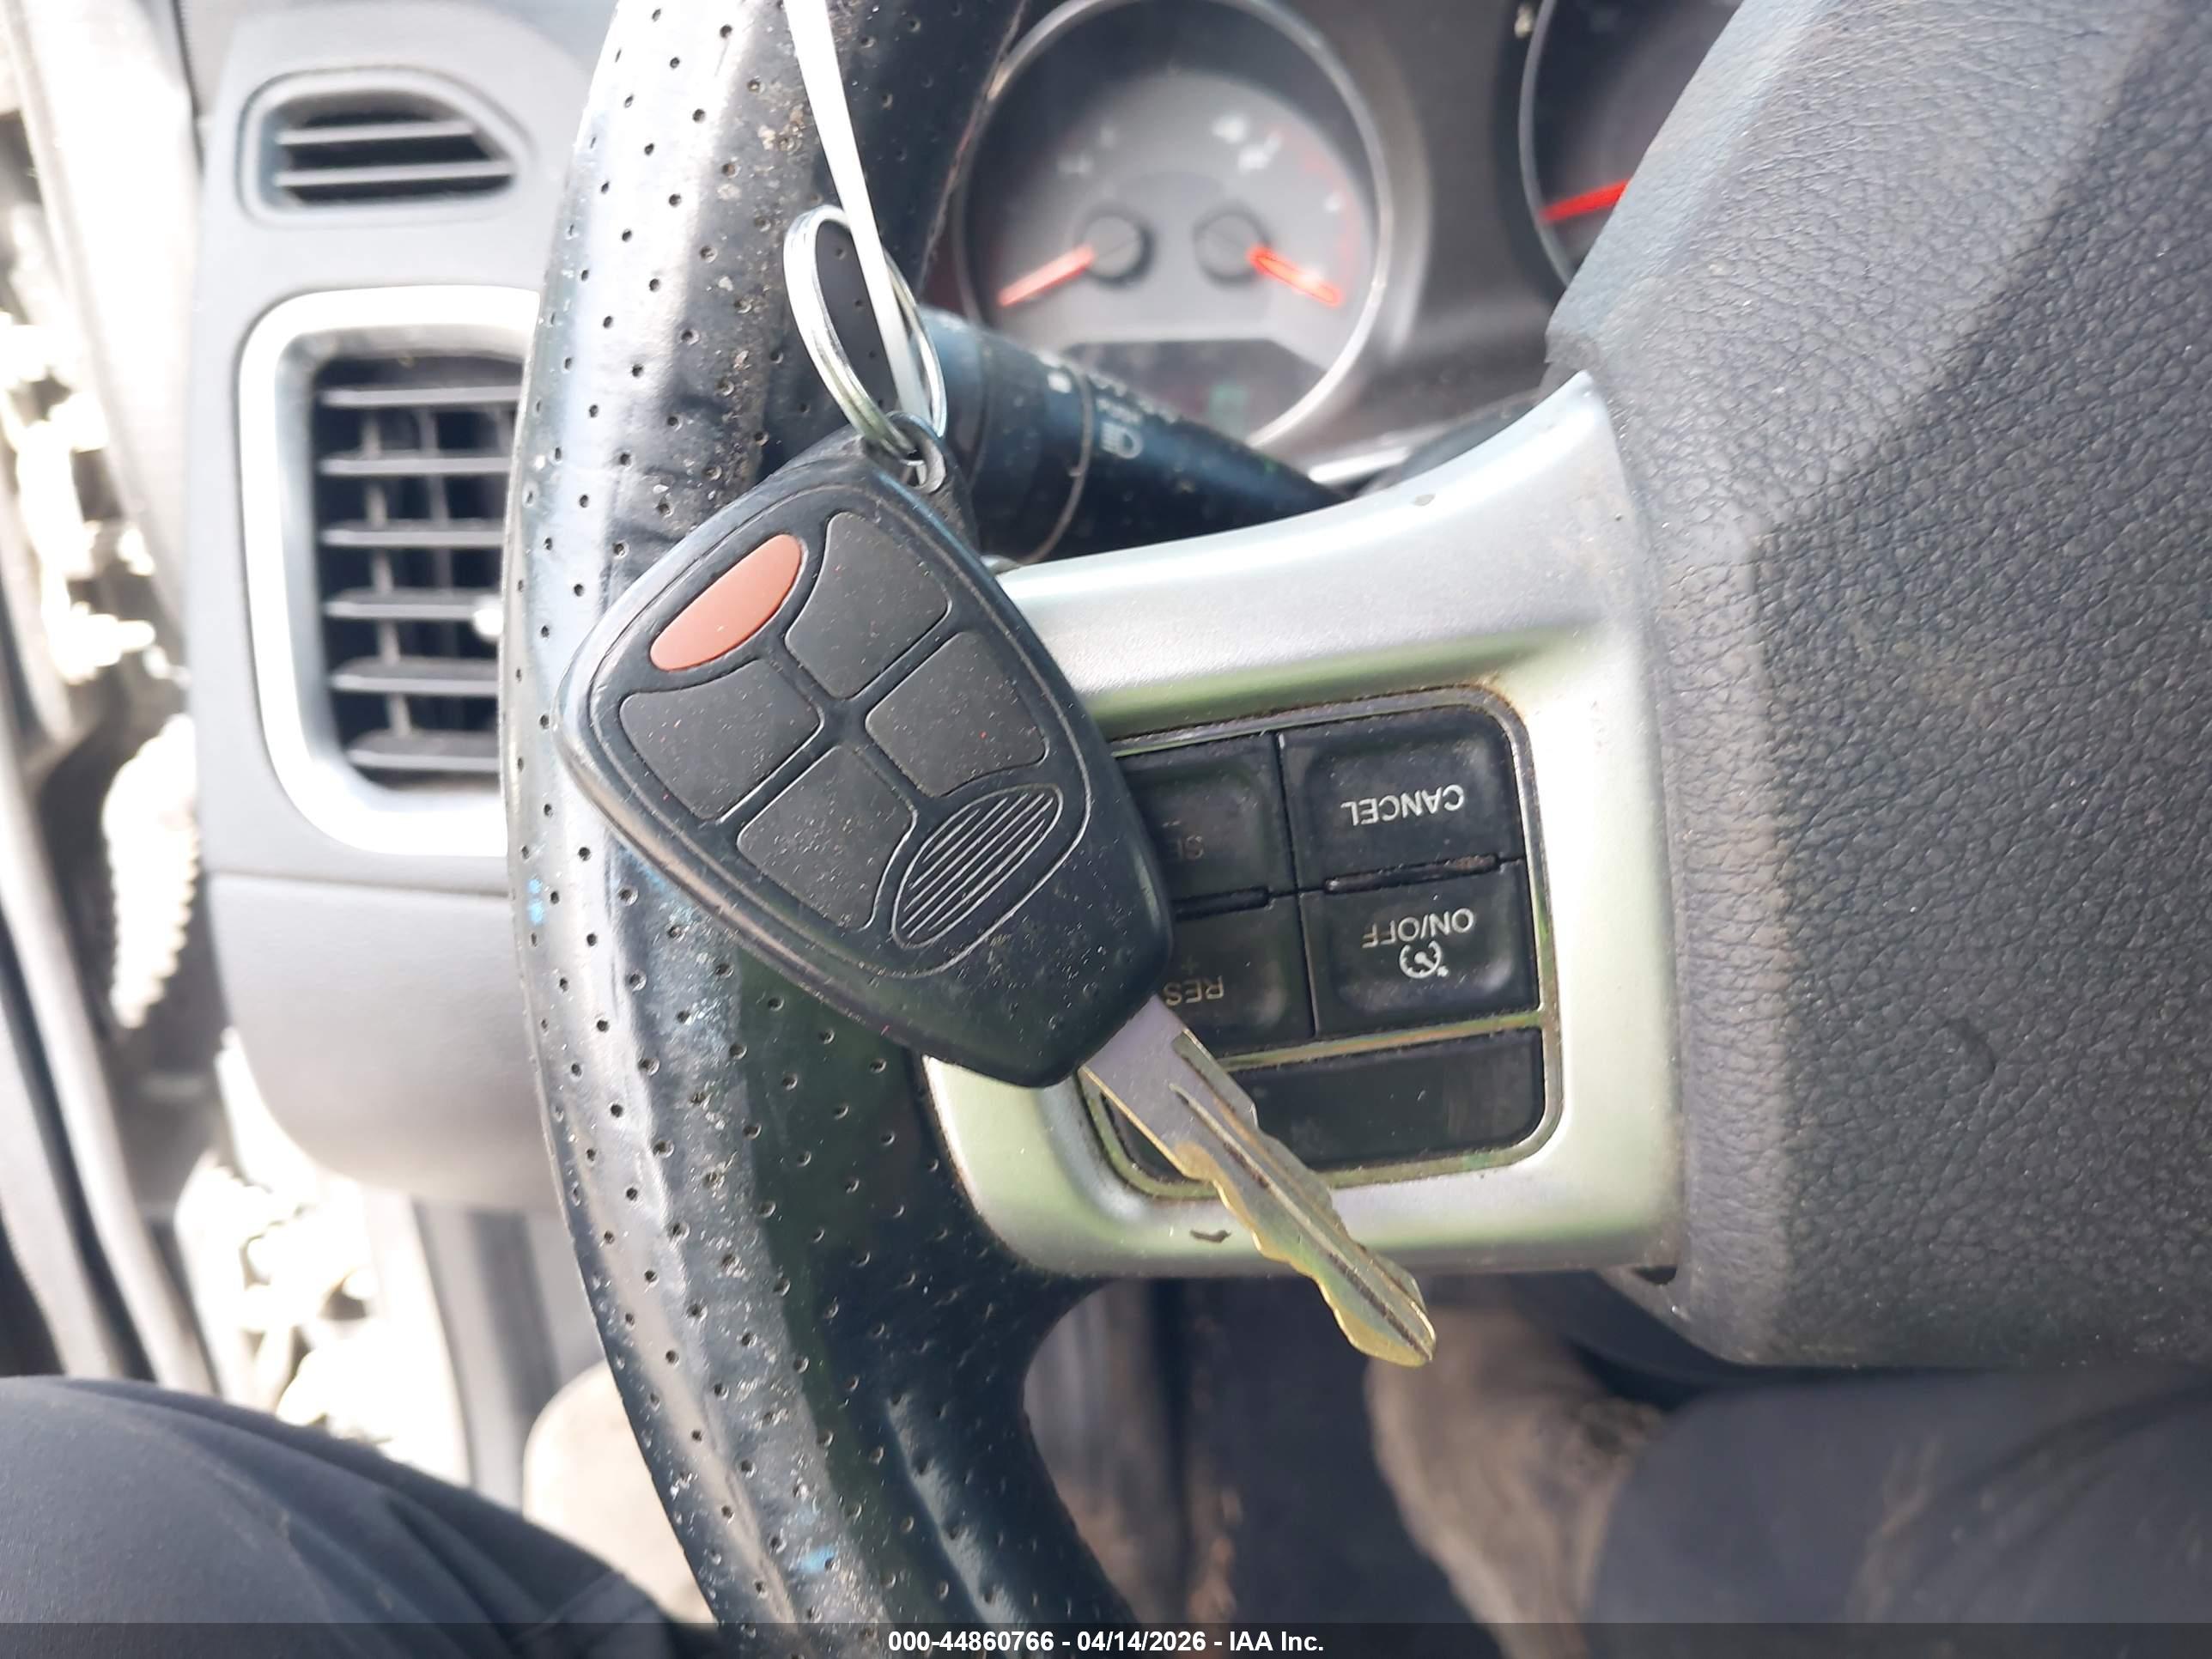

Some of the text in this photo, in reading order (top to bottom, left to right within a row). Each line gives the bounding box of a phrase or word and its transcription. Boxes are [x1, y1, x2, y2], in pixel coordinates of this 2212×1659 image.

[1340, 783, 1465, 825] CANCEL
[1362, 907, 1474, 948] ON/OFF
[1163, 975, 1224, 1006] RES
